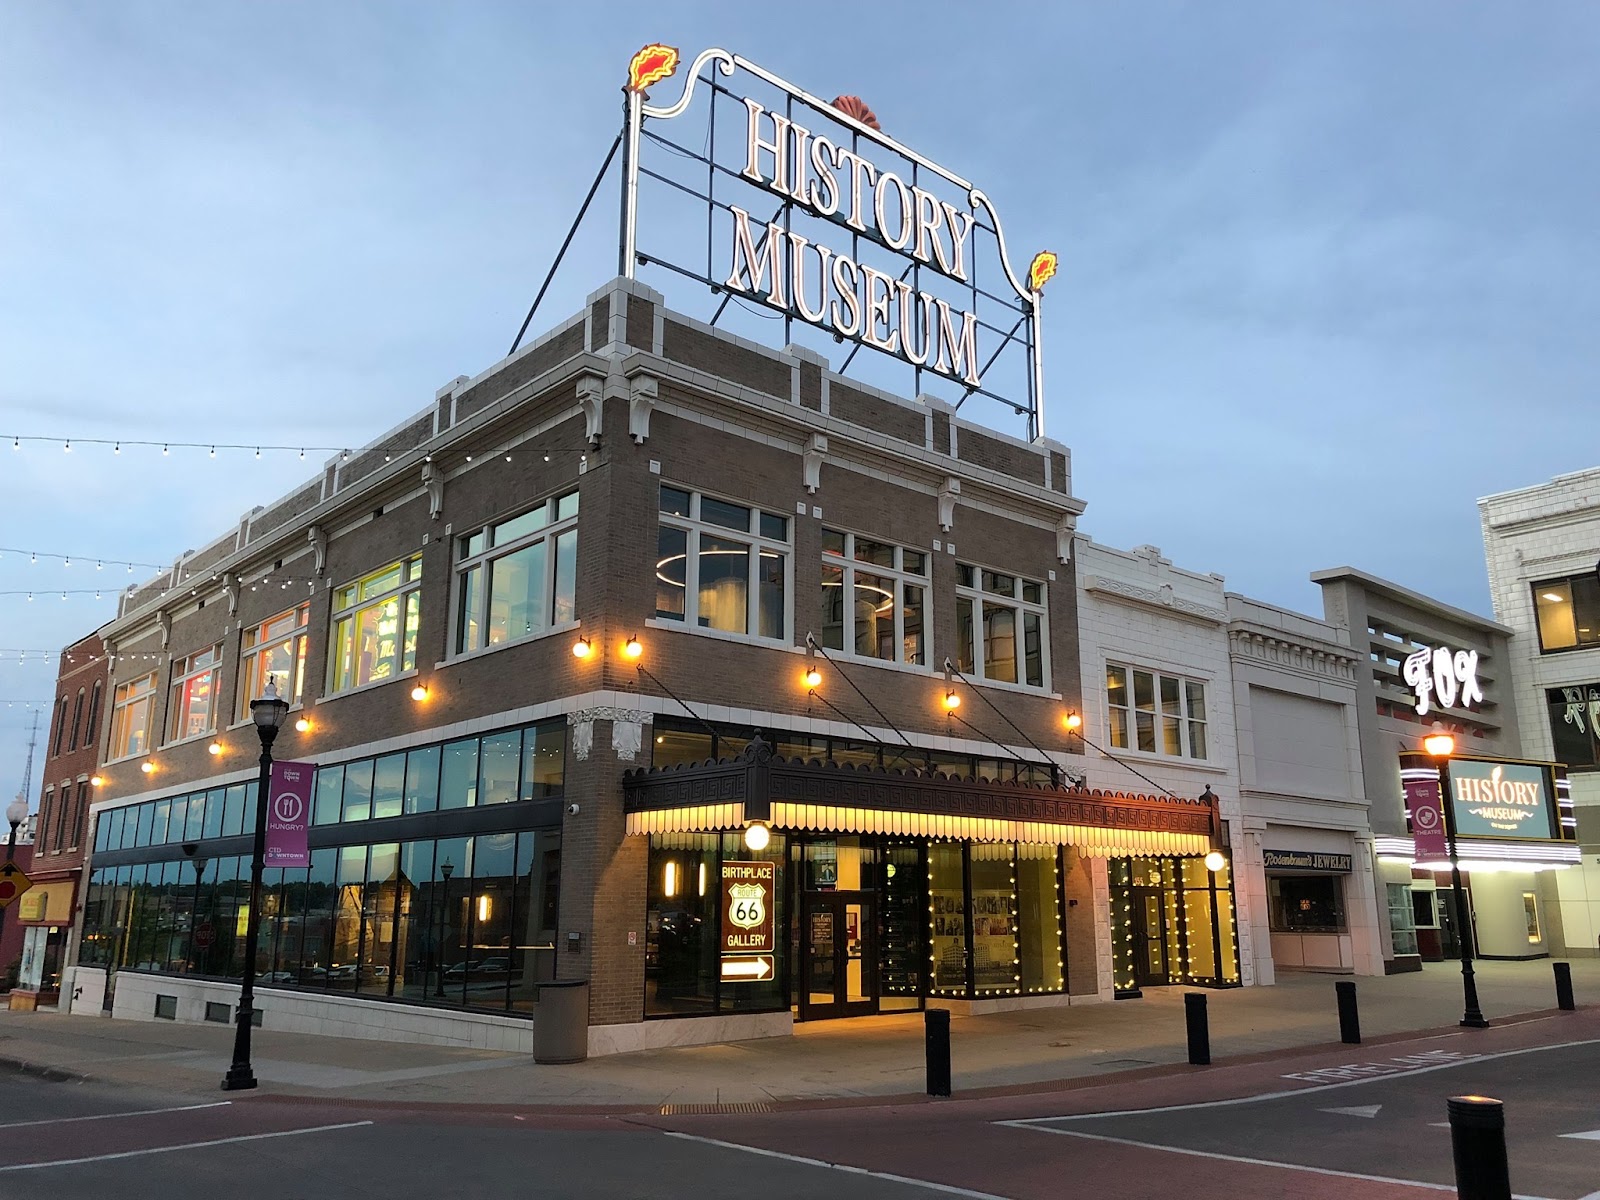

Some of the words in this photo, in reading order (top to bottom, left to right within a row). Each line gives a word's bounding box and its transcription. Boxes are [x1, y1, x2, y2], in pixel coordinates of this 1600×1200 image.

[742, 97, 976, 282] HISTORY
[725, 205, 982, 388] MUSEUM
[1403, 647, 1483, 716] FOX
[1455, 776, 1539, 806] HISTORY
[1482, 807, 1523, 820] MUSEUM
[269, 823, 304, 831] HUNGRY?
[1313, 854, 1351, 869] JEWELRY
[722, 867, 772, 879] BIRTHPLACE
[737, 889, 757, 897] ROUTE
[736, 902, 758, 921] 66
[727, 934, 766, 947] GALLERY
[1280, 1063, 1399, 1083] FIRE
[1365, 1049, 1482, 1069] LANE
